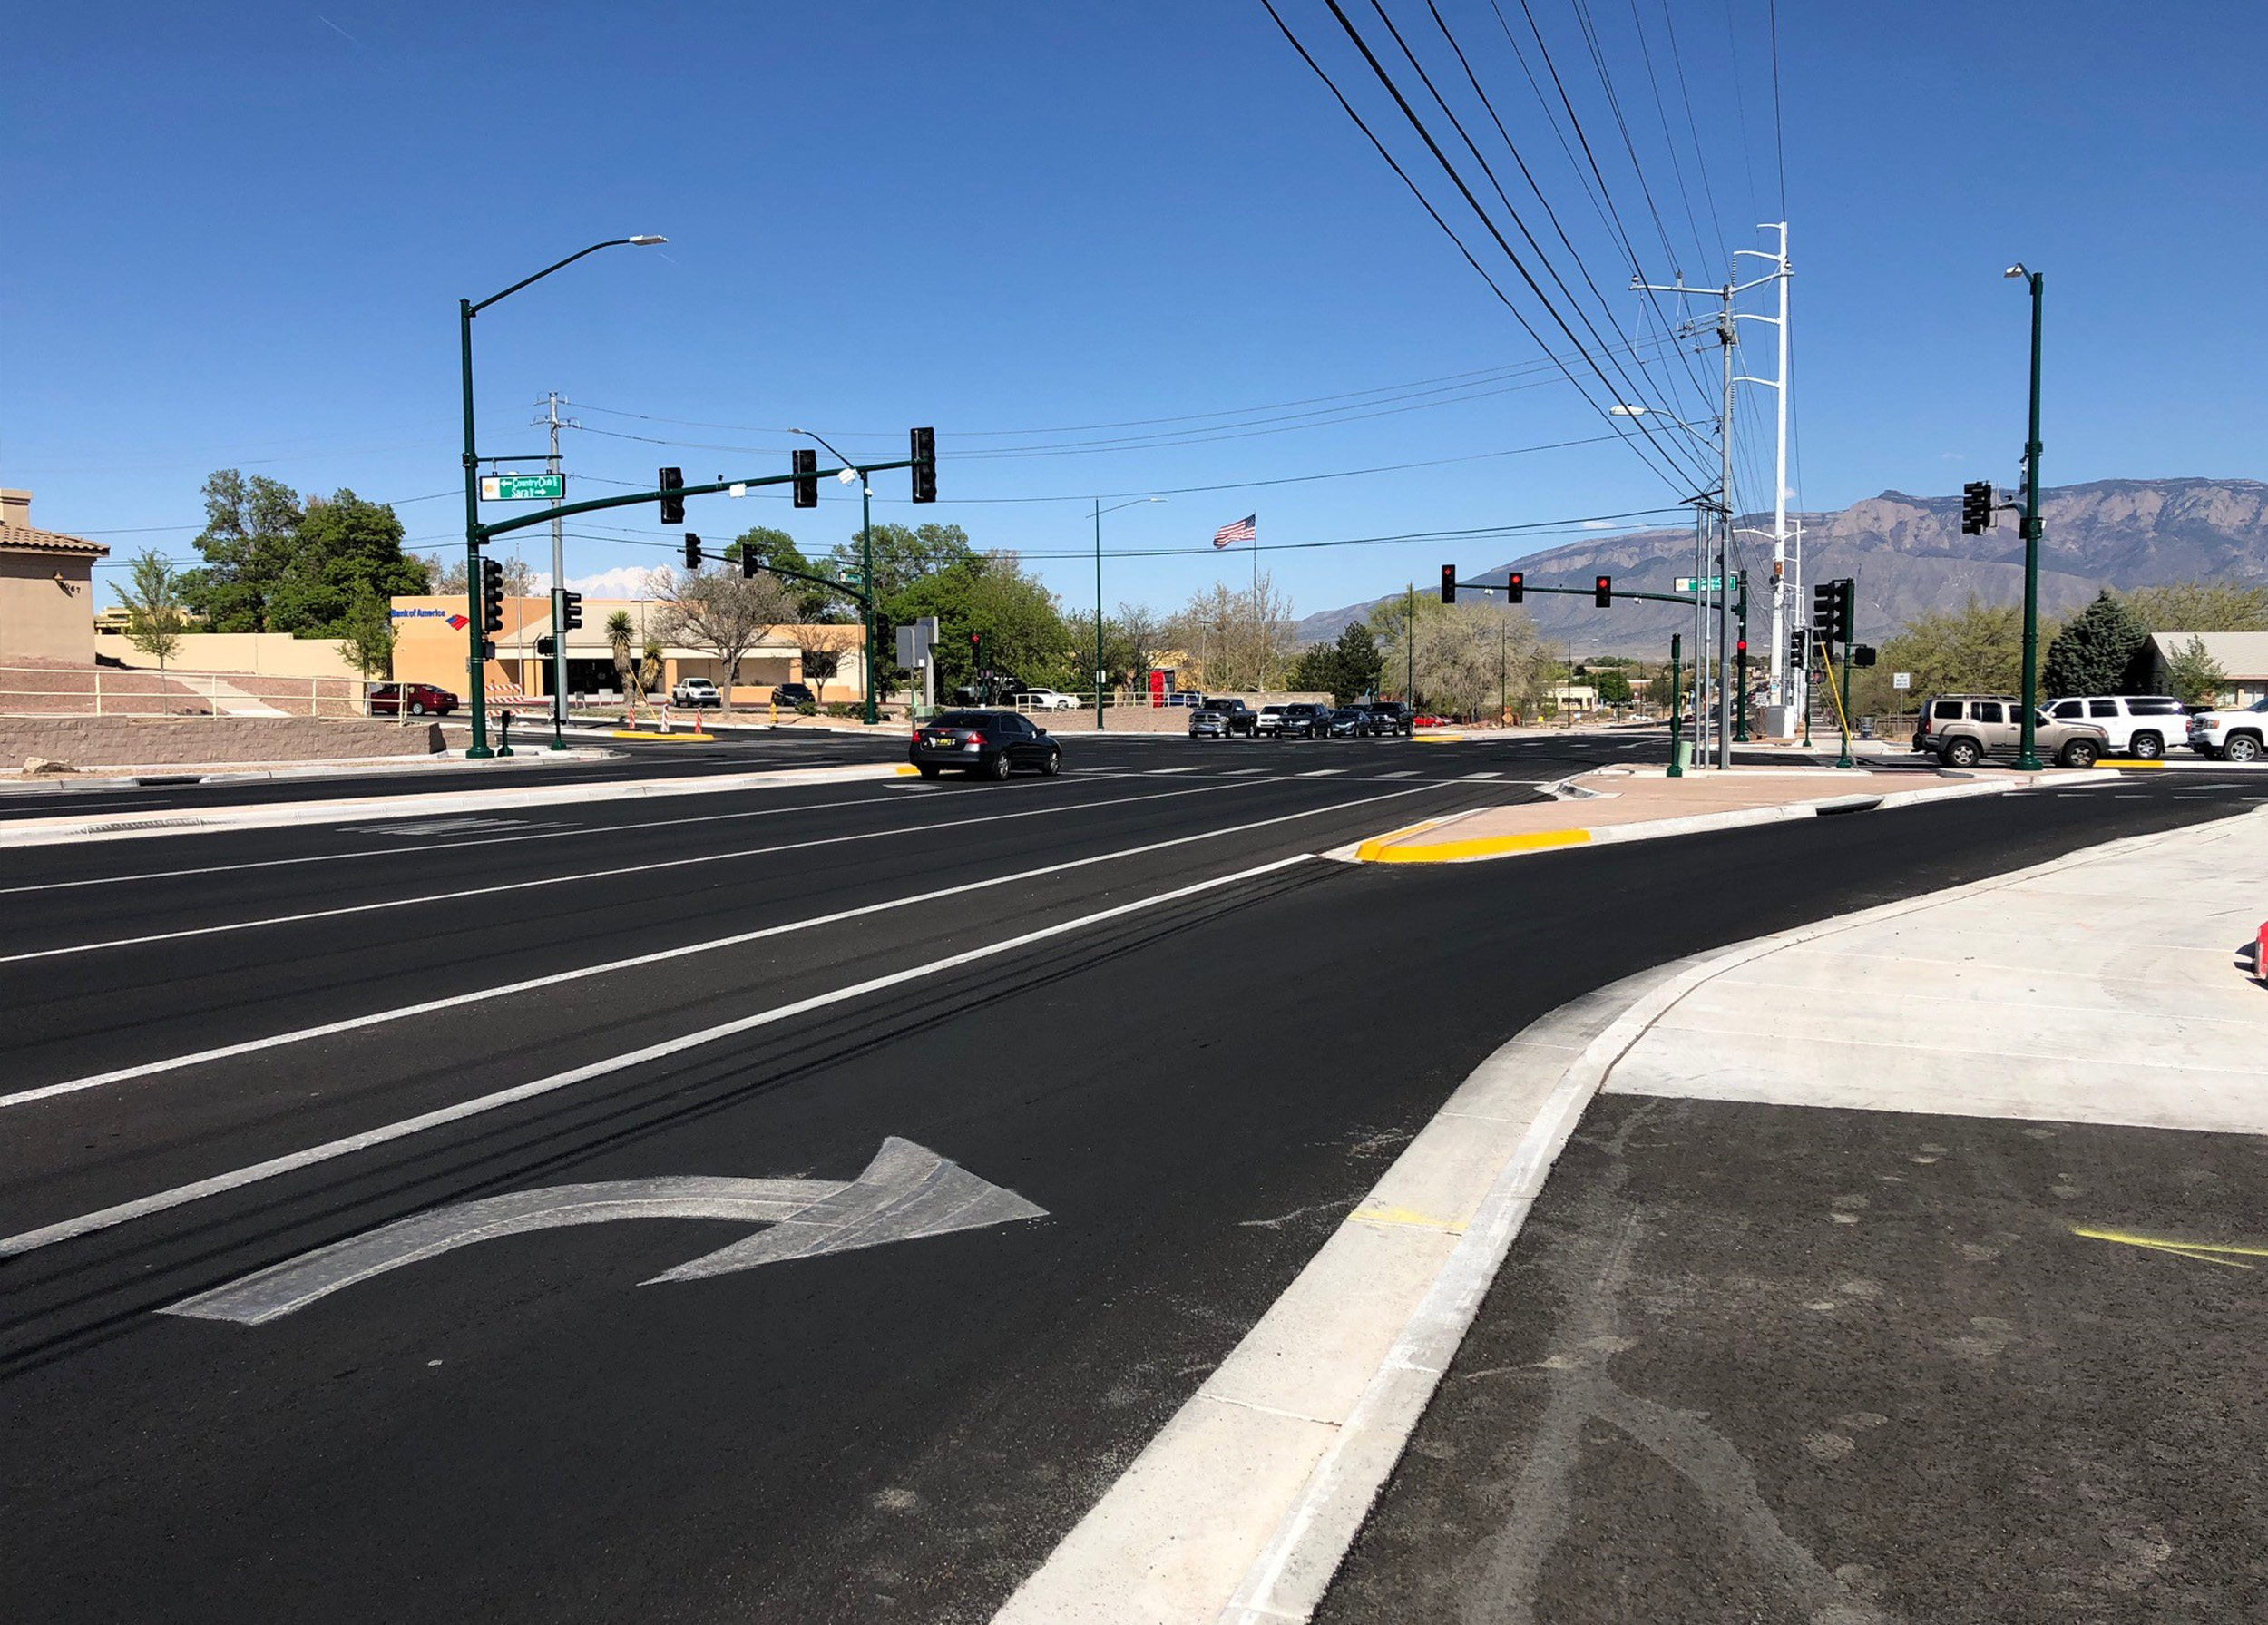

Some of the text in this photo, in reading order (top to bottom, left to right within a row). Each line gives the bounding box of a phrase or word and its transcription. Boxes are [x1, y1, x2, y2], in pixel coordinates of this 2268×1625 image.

[513, 477, 539, 488] Country
[511, 487, 529, 498] Sara
[59, 582, 81, 594] 067
[391, 608, 445, 618] Bank of America
